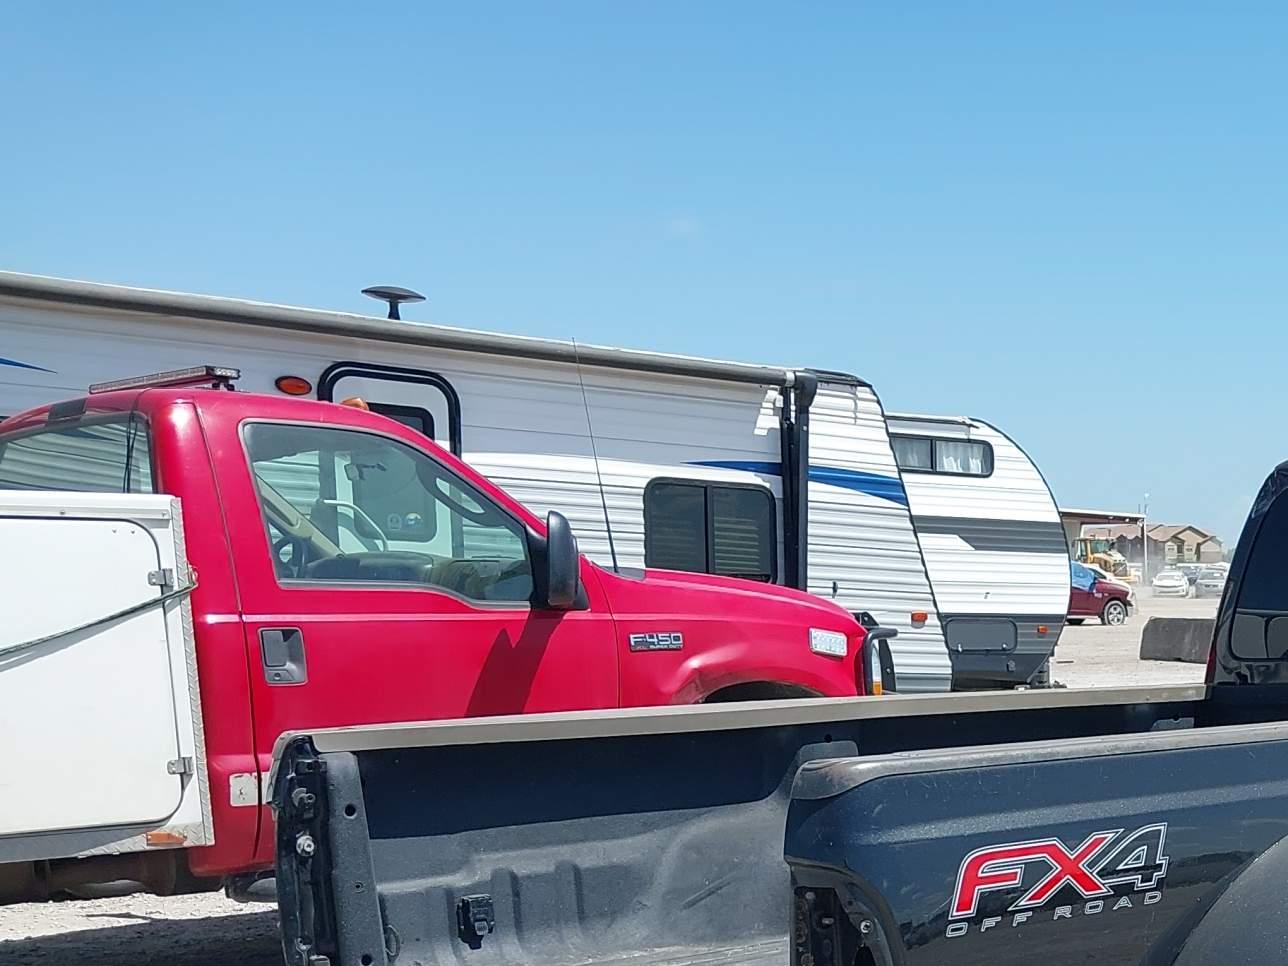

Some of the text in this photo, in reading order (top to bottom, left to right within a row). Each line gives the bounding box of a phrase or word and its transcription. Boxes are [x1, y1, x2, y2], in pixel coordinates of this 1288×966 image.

[948, 822, 1169, 920] FX4
[945, 891, 1162, 938] OFF ROAD
